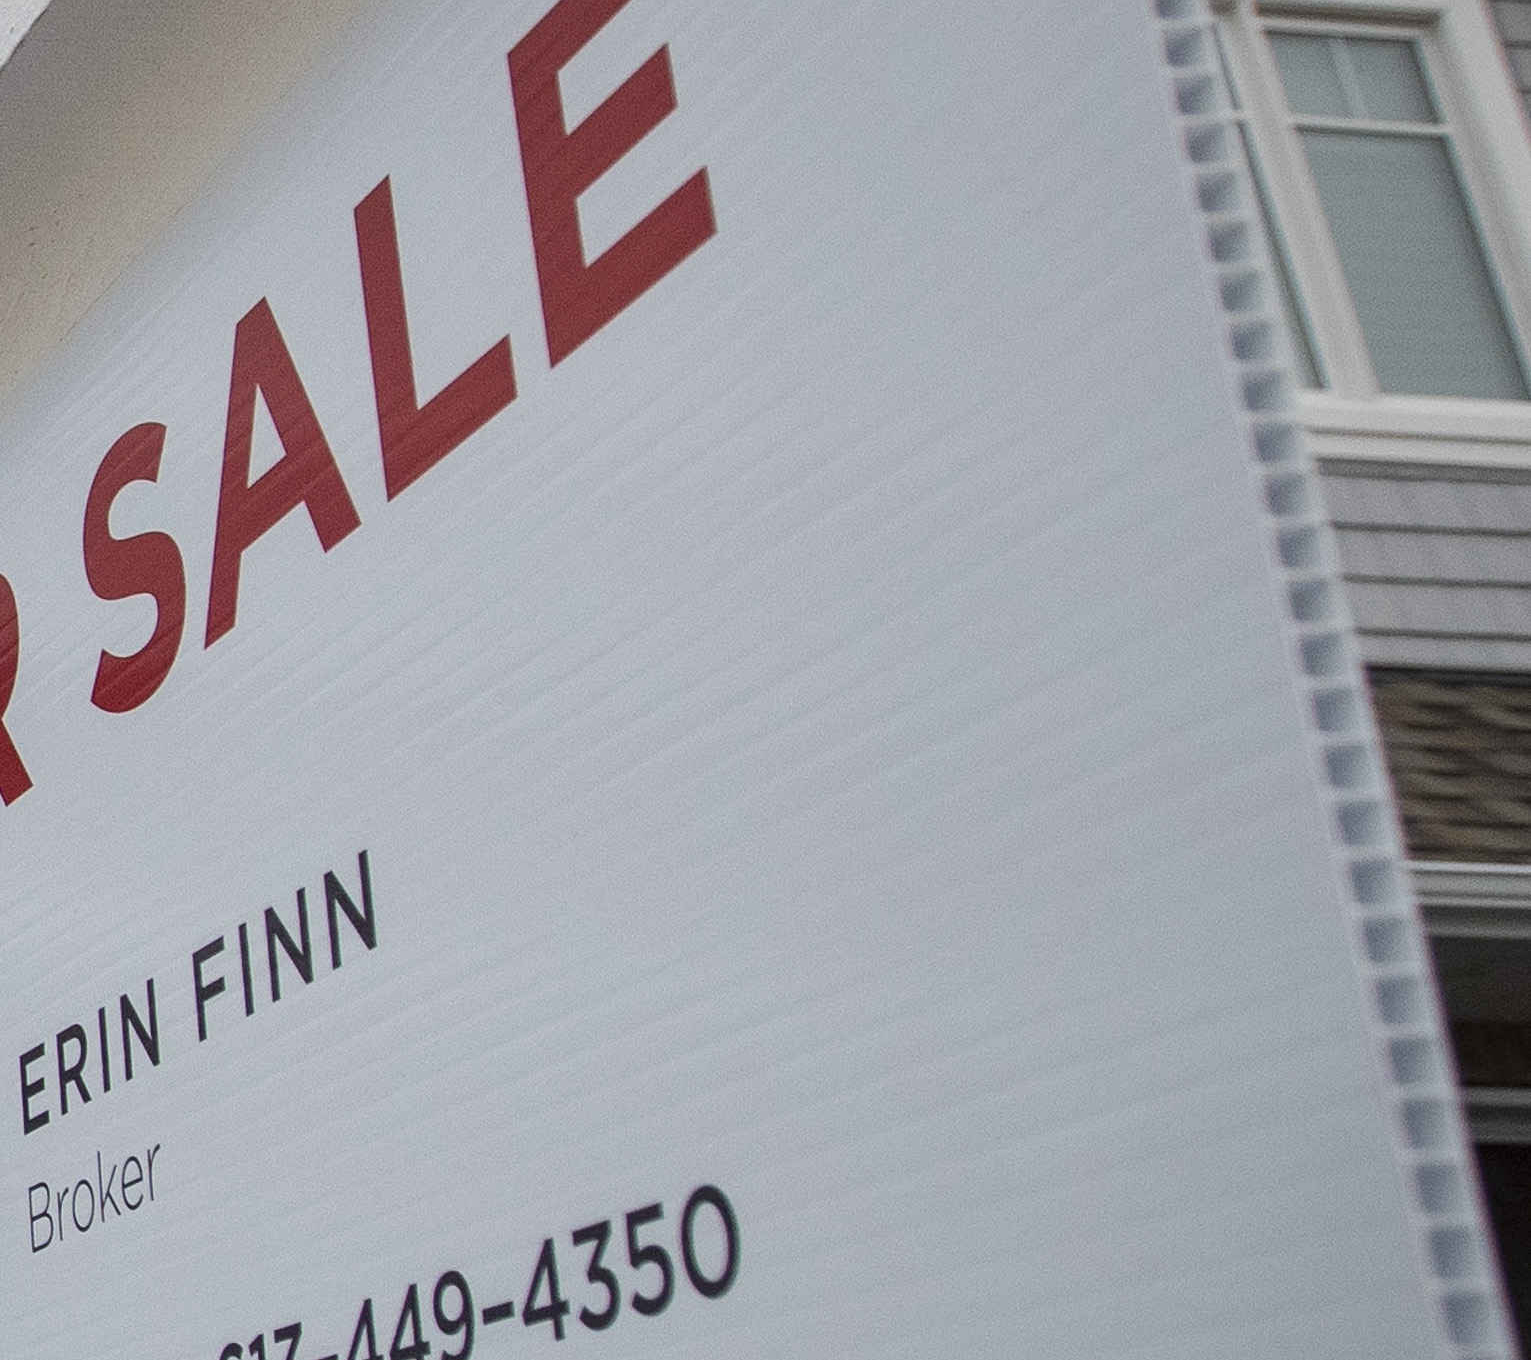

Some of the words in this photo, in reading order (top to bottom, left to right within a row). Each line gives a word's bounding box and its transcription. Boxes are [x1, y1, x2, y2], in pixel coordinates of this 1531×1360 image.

[18, 978, 161, 1134] ERIN
[192, 850, 379, 1041] FINN
[28, 1144, 162, 1253] Broker
